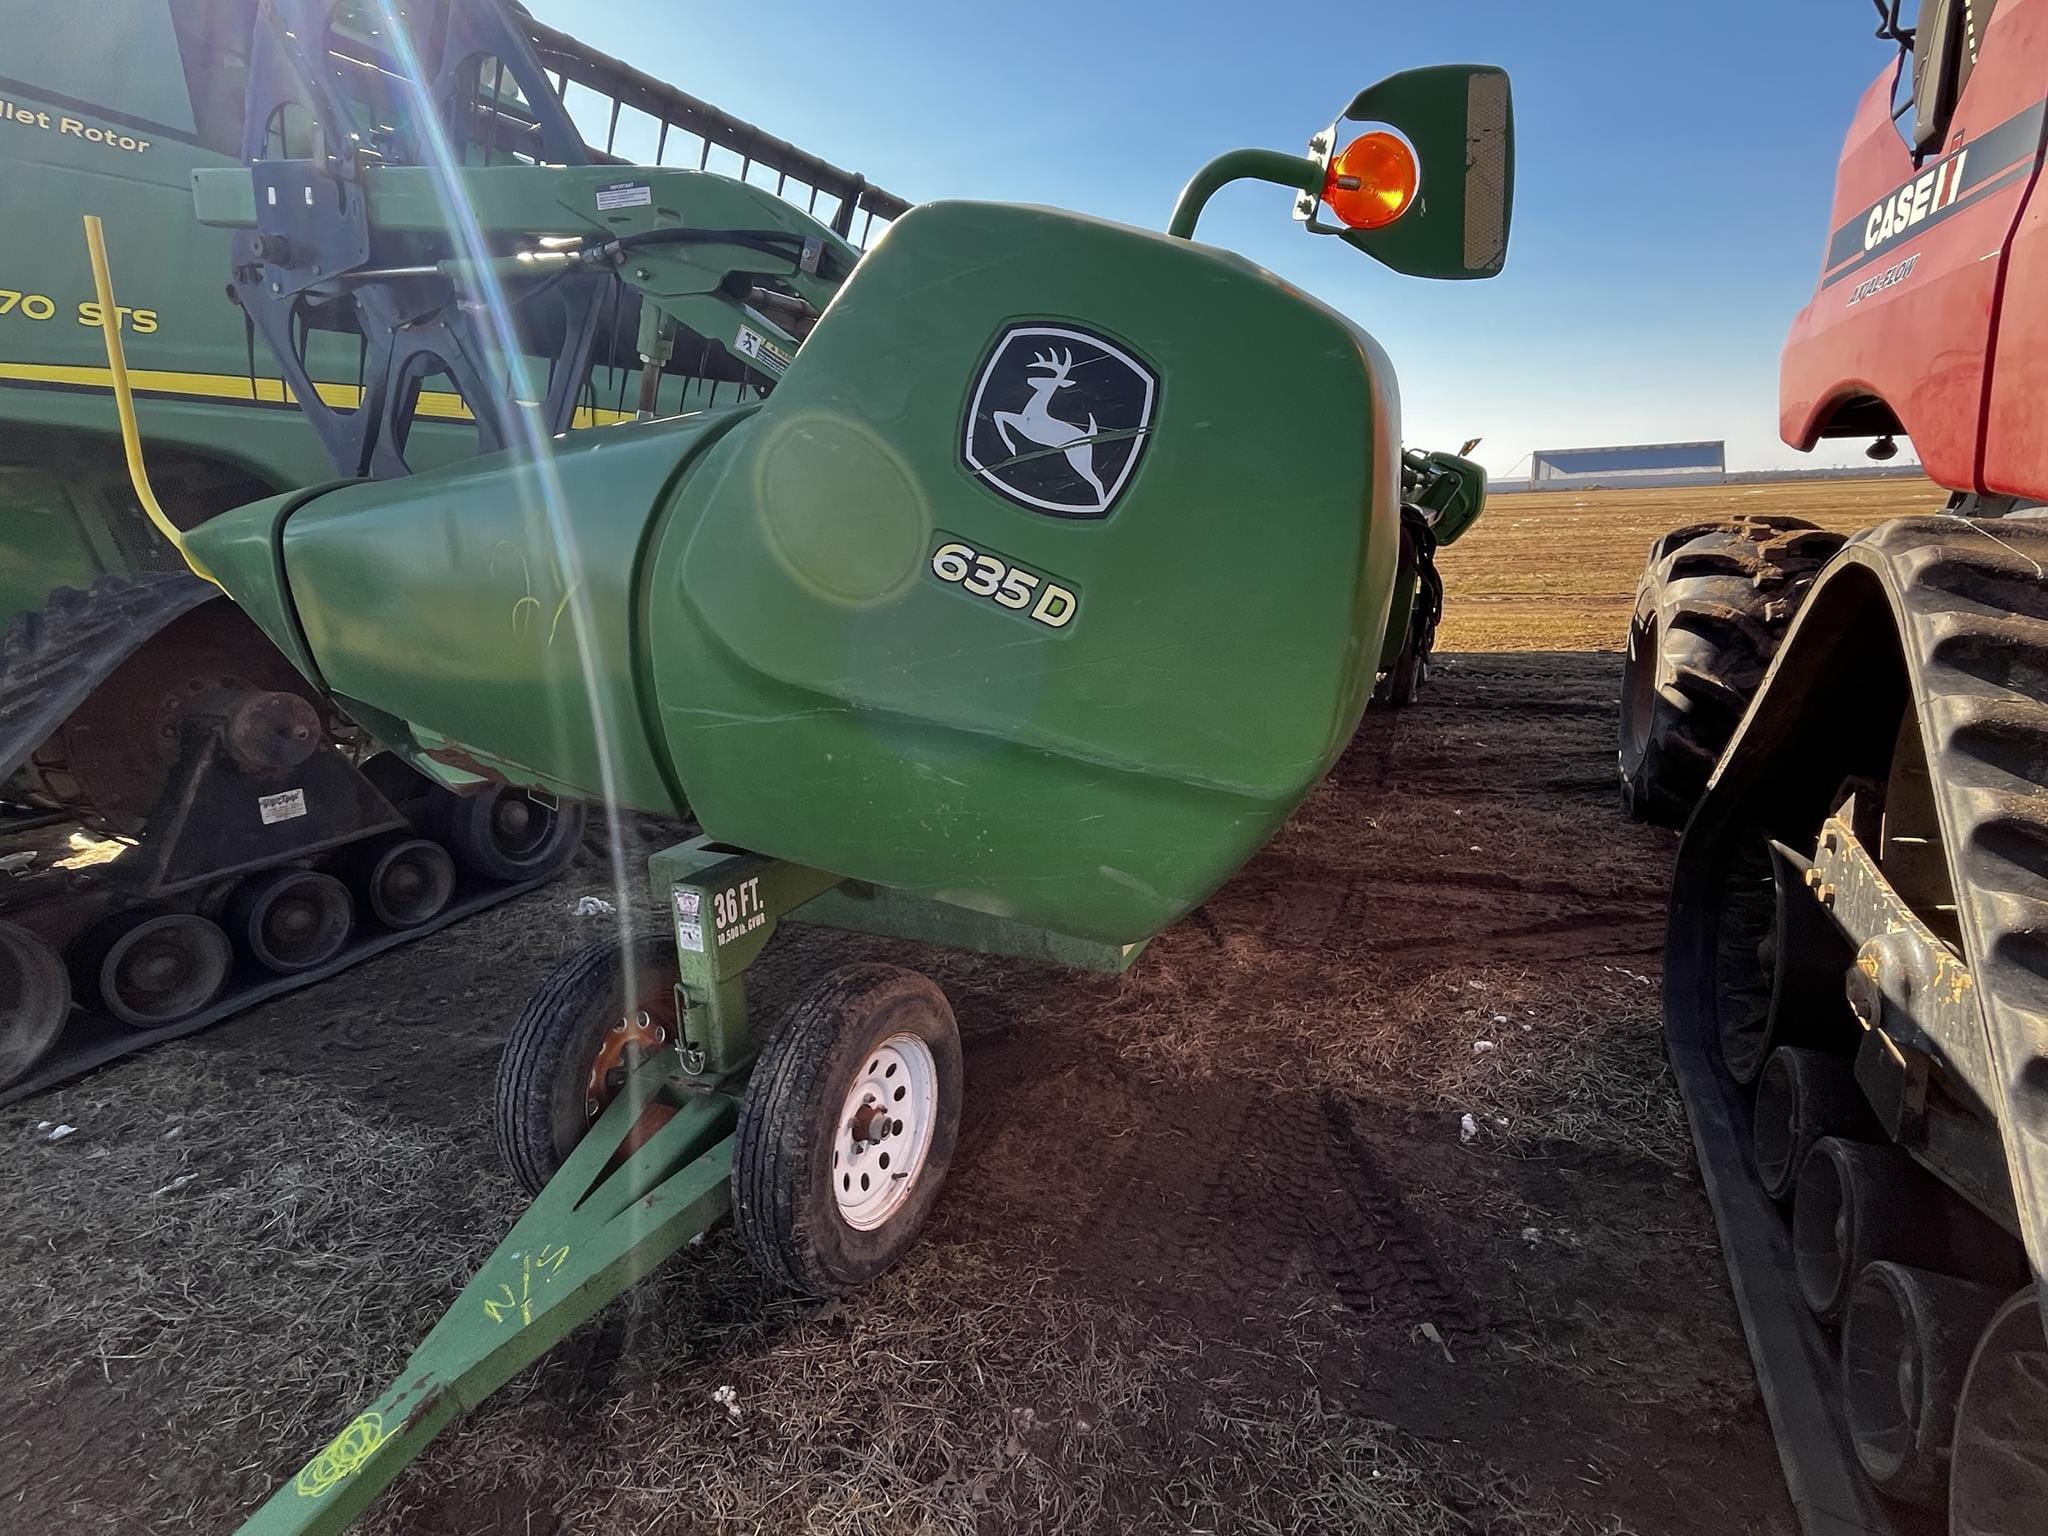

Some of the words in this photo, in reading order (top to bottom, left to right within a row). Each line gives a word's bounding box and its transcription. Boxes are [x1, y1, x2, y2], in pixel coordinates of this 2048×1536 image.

[60, 117, 150, 152] Rotor
[78, 301, 158, 334] STS
[714, 888, 738, 929] 36
[739, 877, 764, 917] FT.
